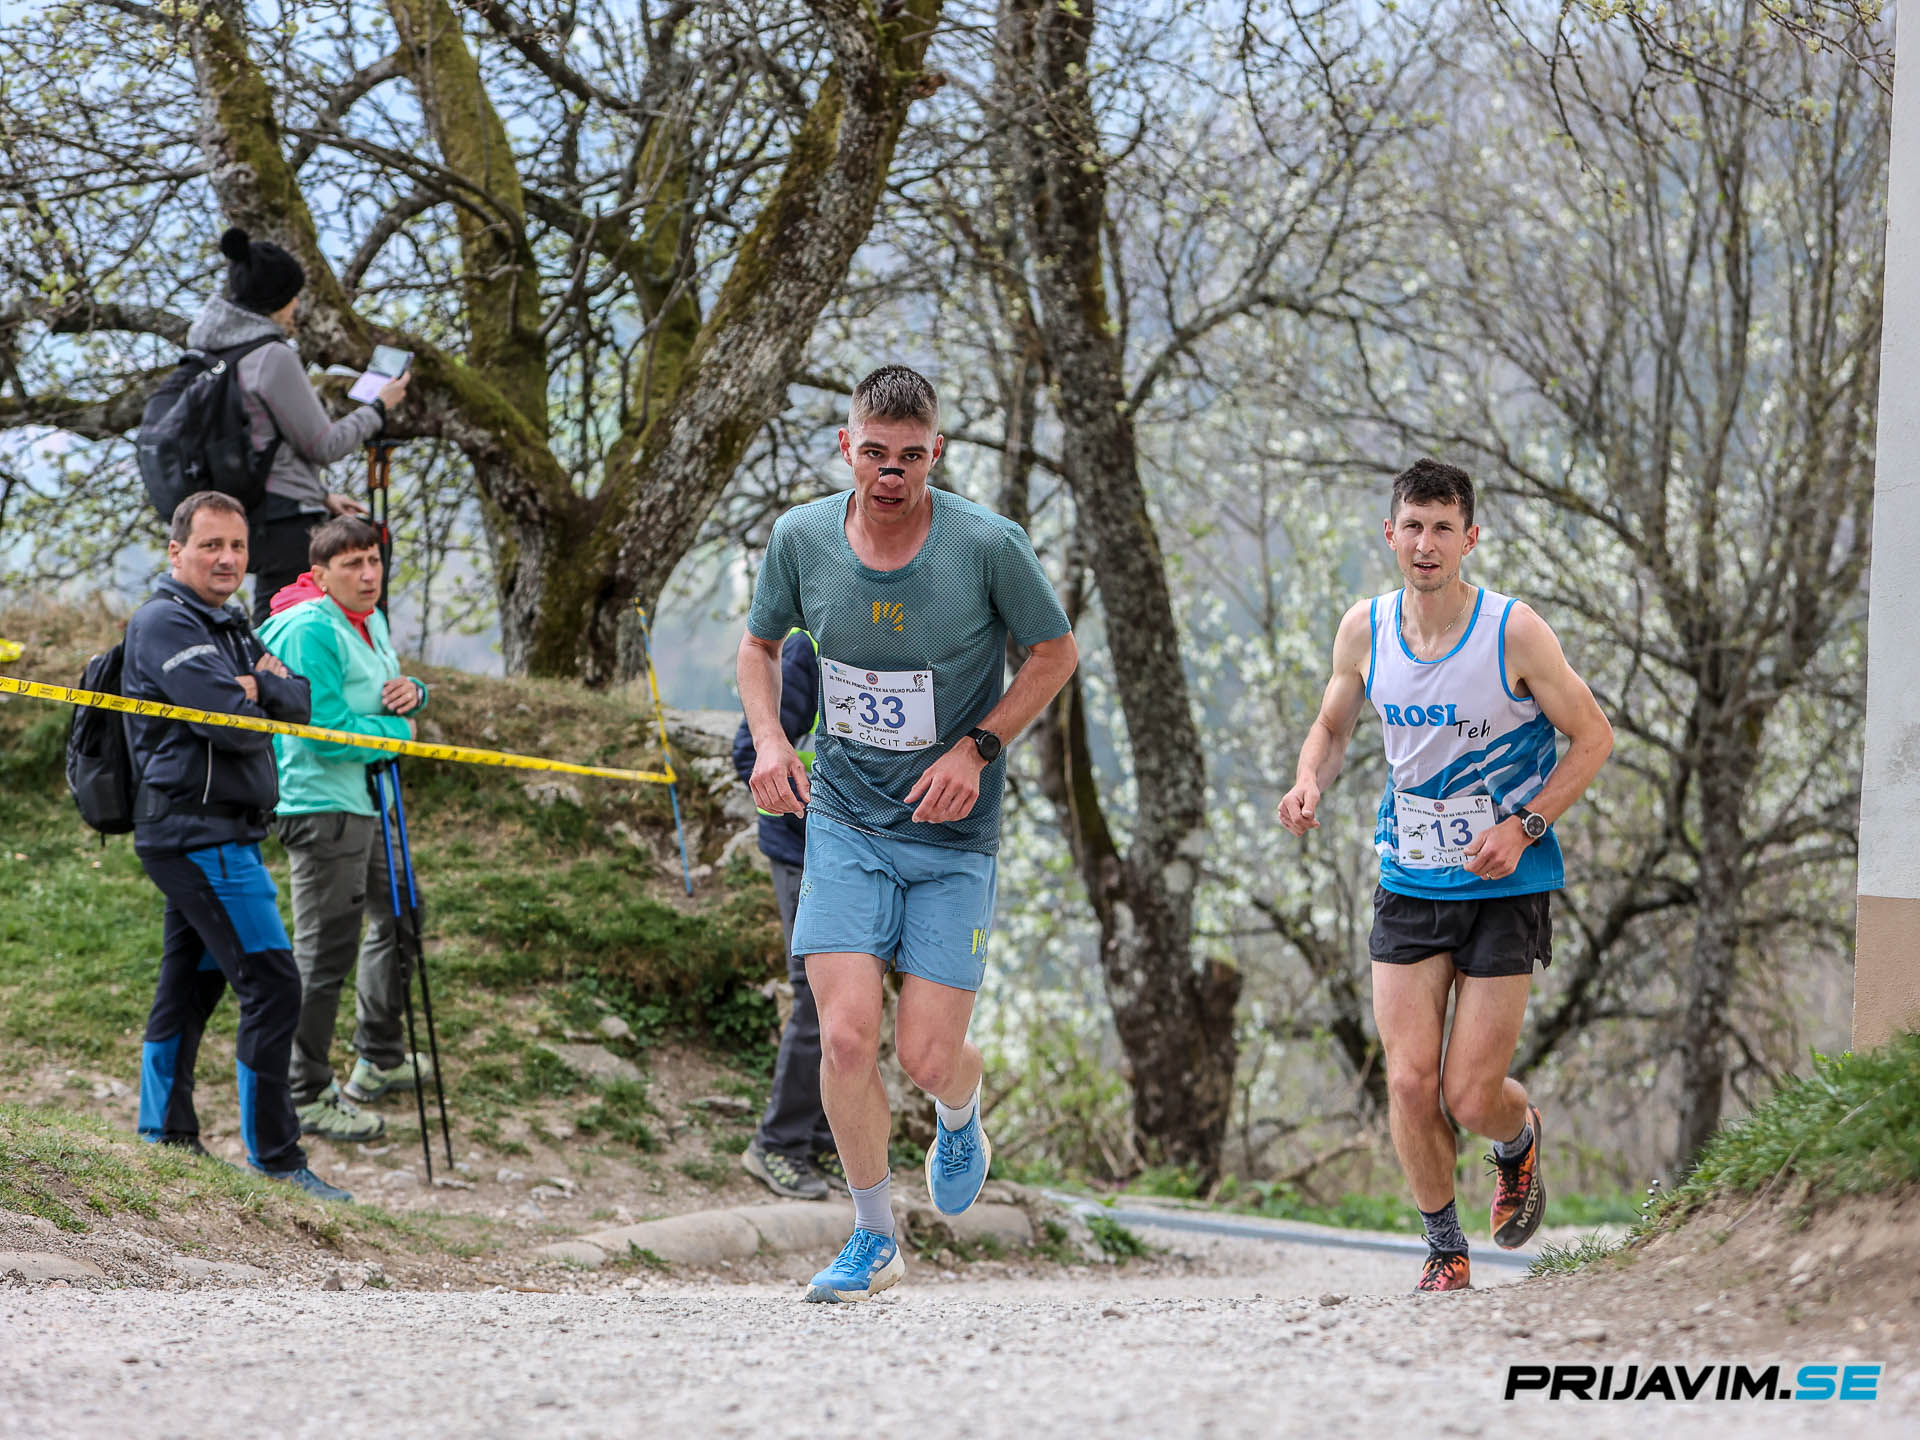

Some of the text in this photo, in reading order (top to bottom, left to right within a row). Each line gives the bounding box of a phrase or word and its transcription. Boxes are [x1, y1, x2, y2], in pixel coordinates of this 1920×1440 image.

[858, 692, 906, 729] 33
[1384, 703, 1458, 727] ROSI
[859, 732, 900, 747] CALCIT
[1453, 719, 1491, 738] Teh
[1430, 818, 1473, 848] 13
[1516, 1174, 1539, 1228] MERR
